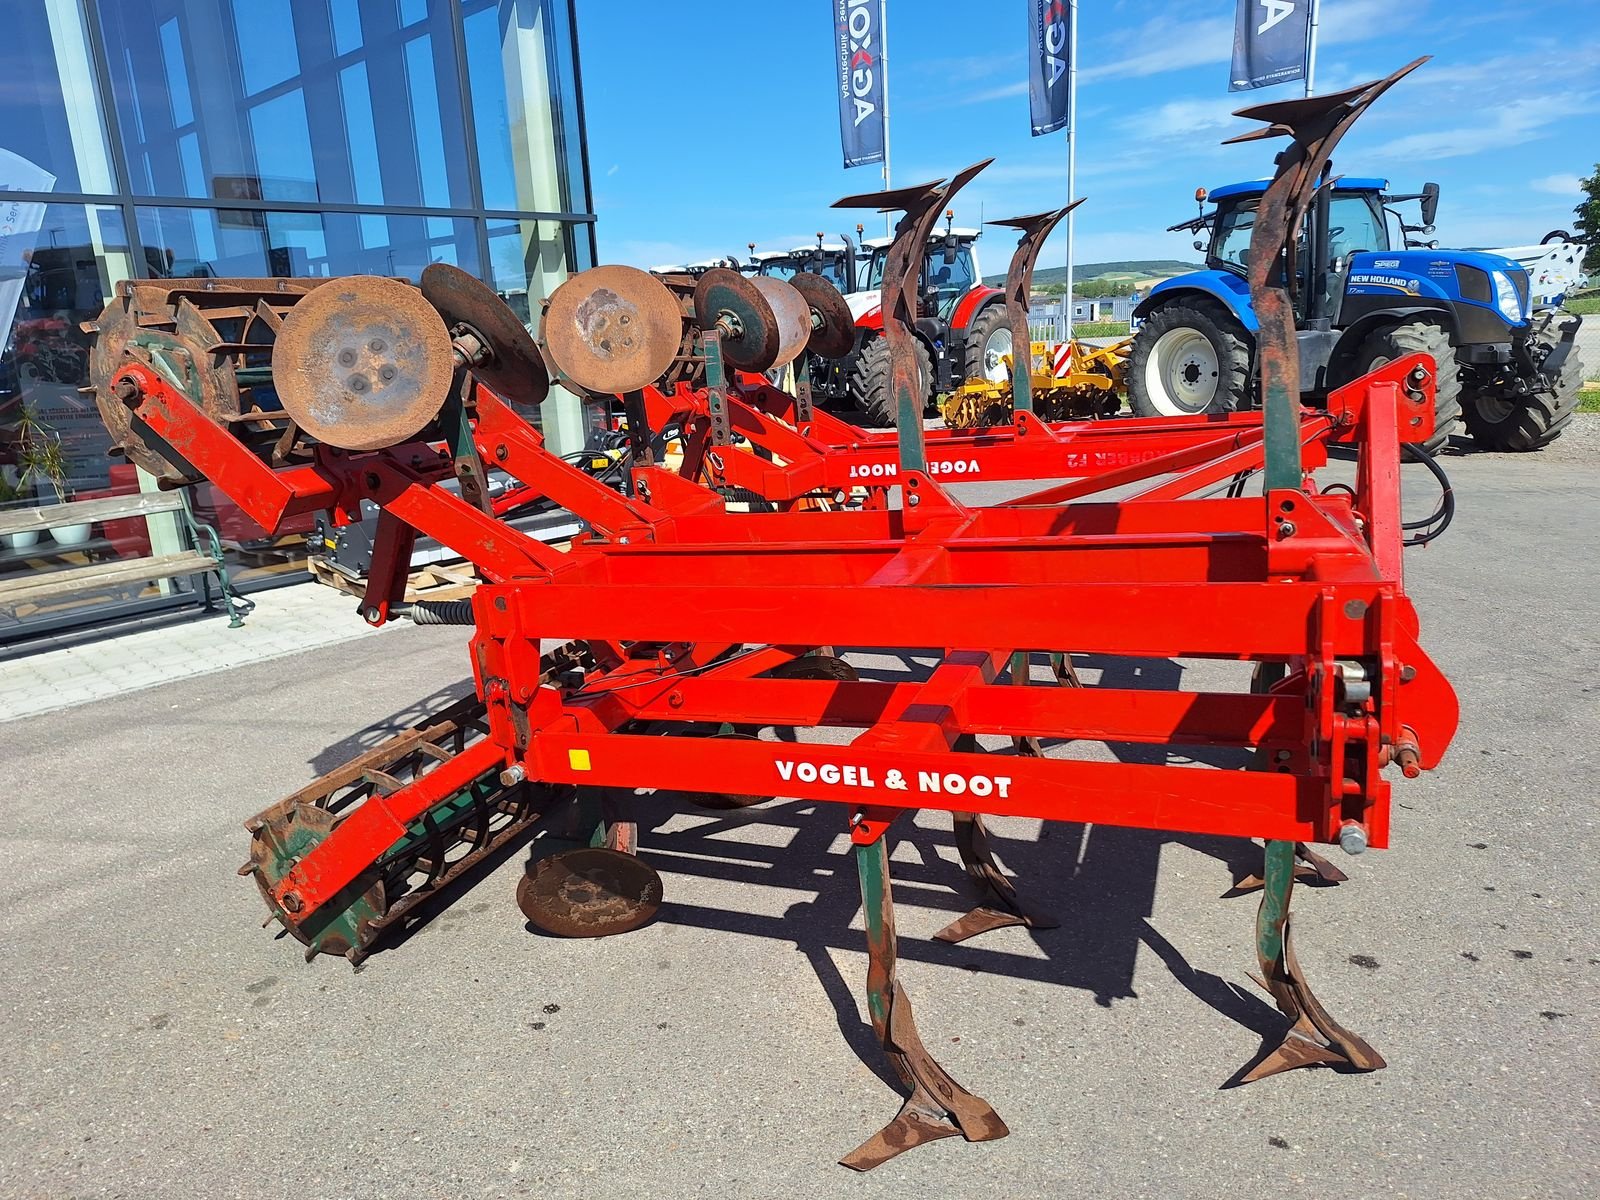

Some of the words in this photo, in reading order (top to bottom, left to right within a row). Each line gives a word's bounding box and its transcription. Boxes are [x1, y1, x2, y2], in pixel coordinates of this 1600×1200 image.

[1350, 275, 1369, 283] NEW
[1370, 276, 1407, 287] HOLLAND
[1067, 453, 1087, 469] F2
[849, 463, 897, 478] NOOT
[775, 760, 875, 788] VOGEL
[884, 768, 908, 790] &
[918, 771, 1012, 798] NOOT
